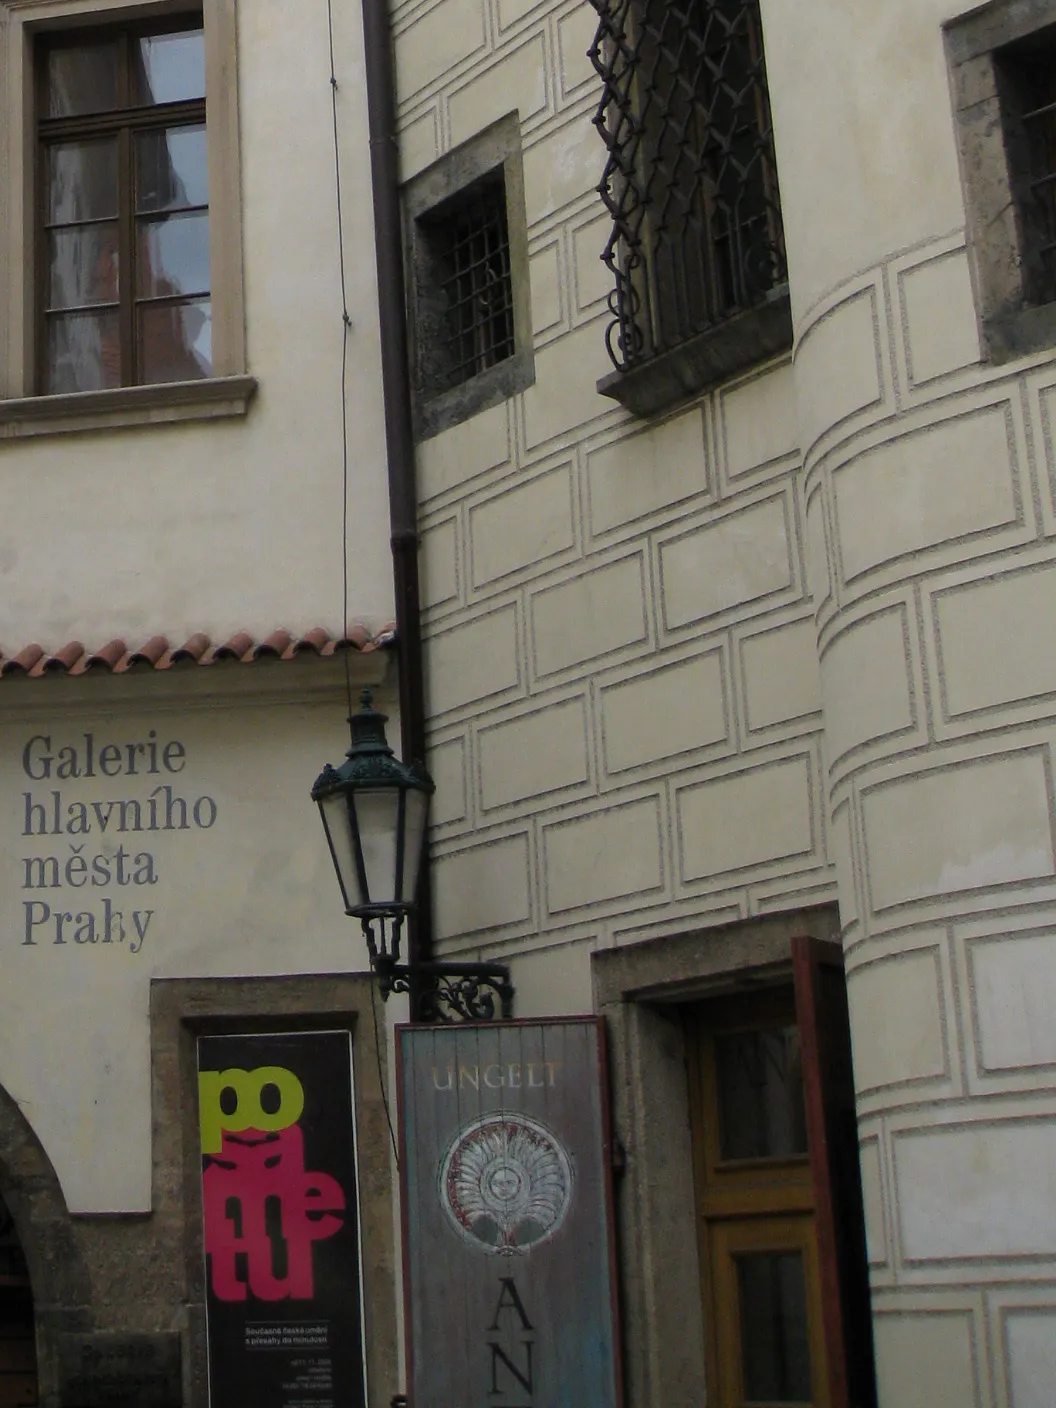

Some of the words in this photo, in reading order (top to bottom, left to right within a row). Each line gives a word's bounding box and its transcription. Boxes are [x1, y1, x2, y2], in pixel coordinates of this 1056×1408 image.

[22, 730, 186, 781] Galerie
[21, 786, 217, 836] hlavního
[21, 844, 158, 889] města
[21, 898, 155, 953] Prahy
[433, 1061, 561, 1090] UNGELT
